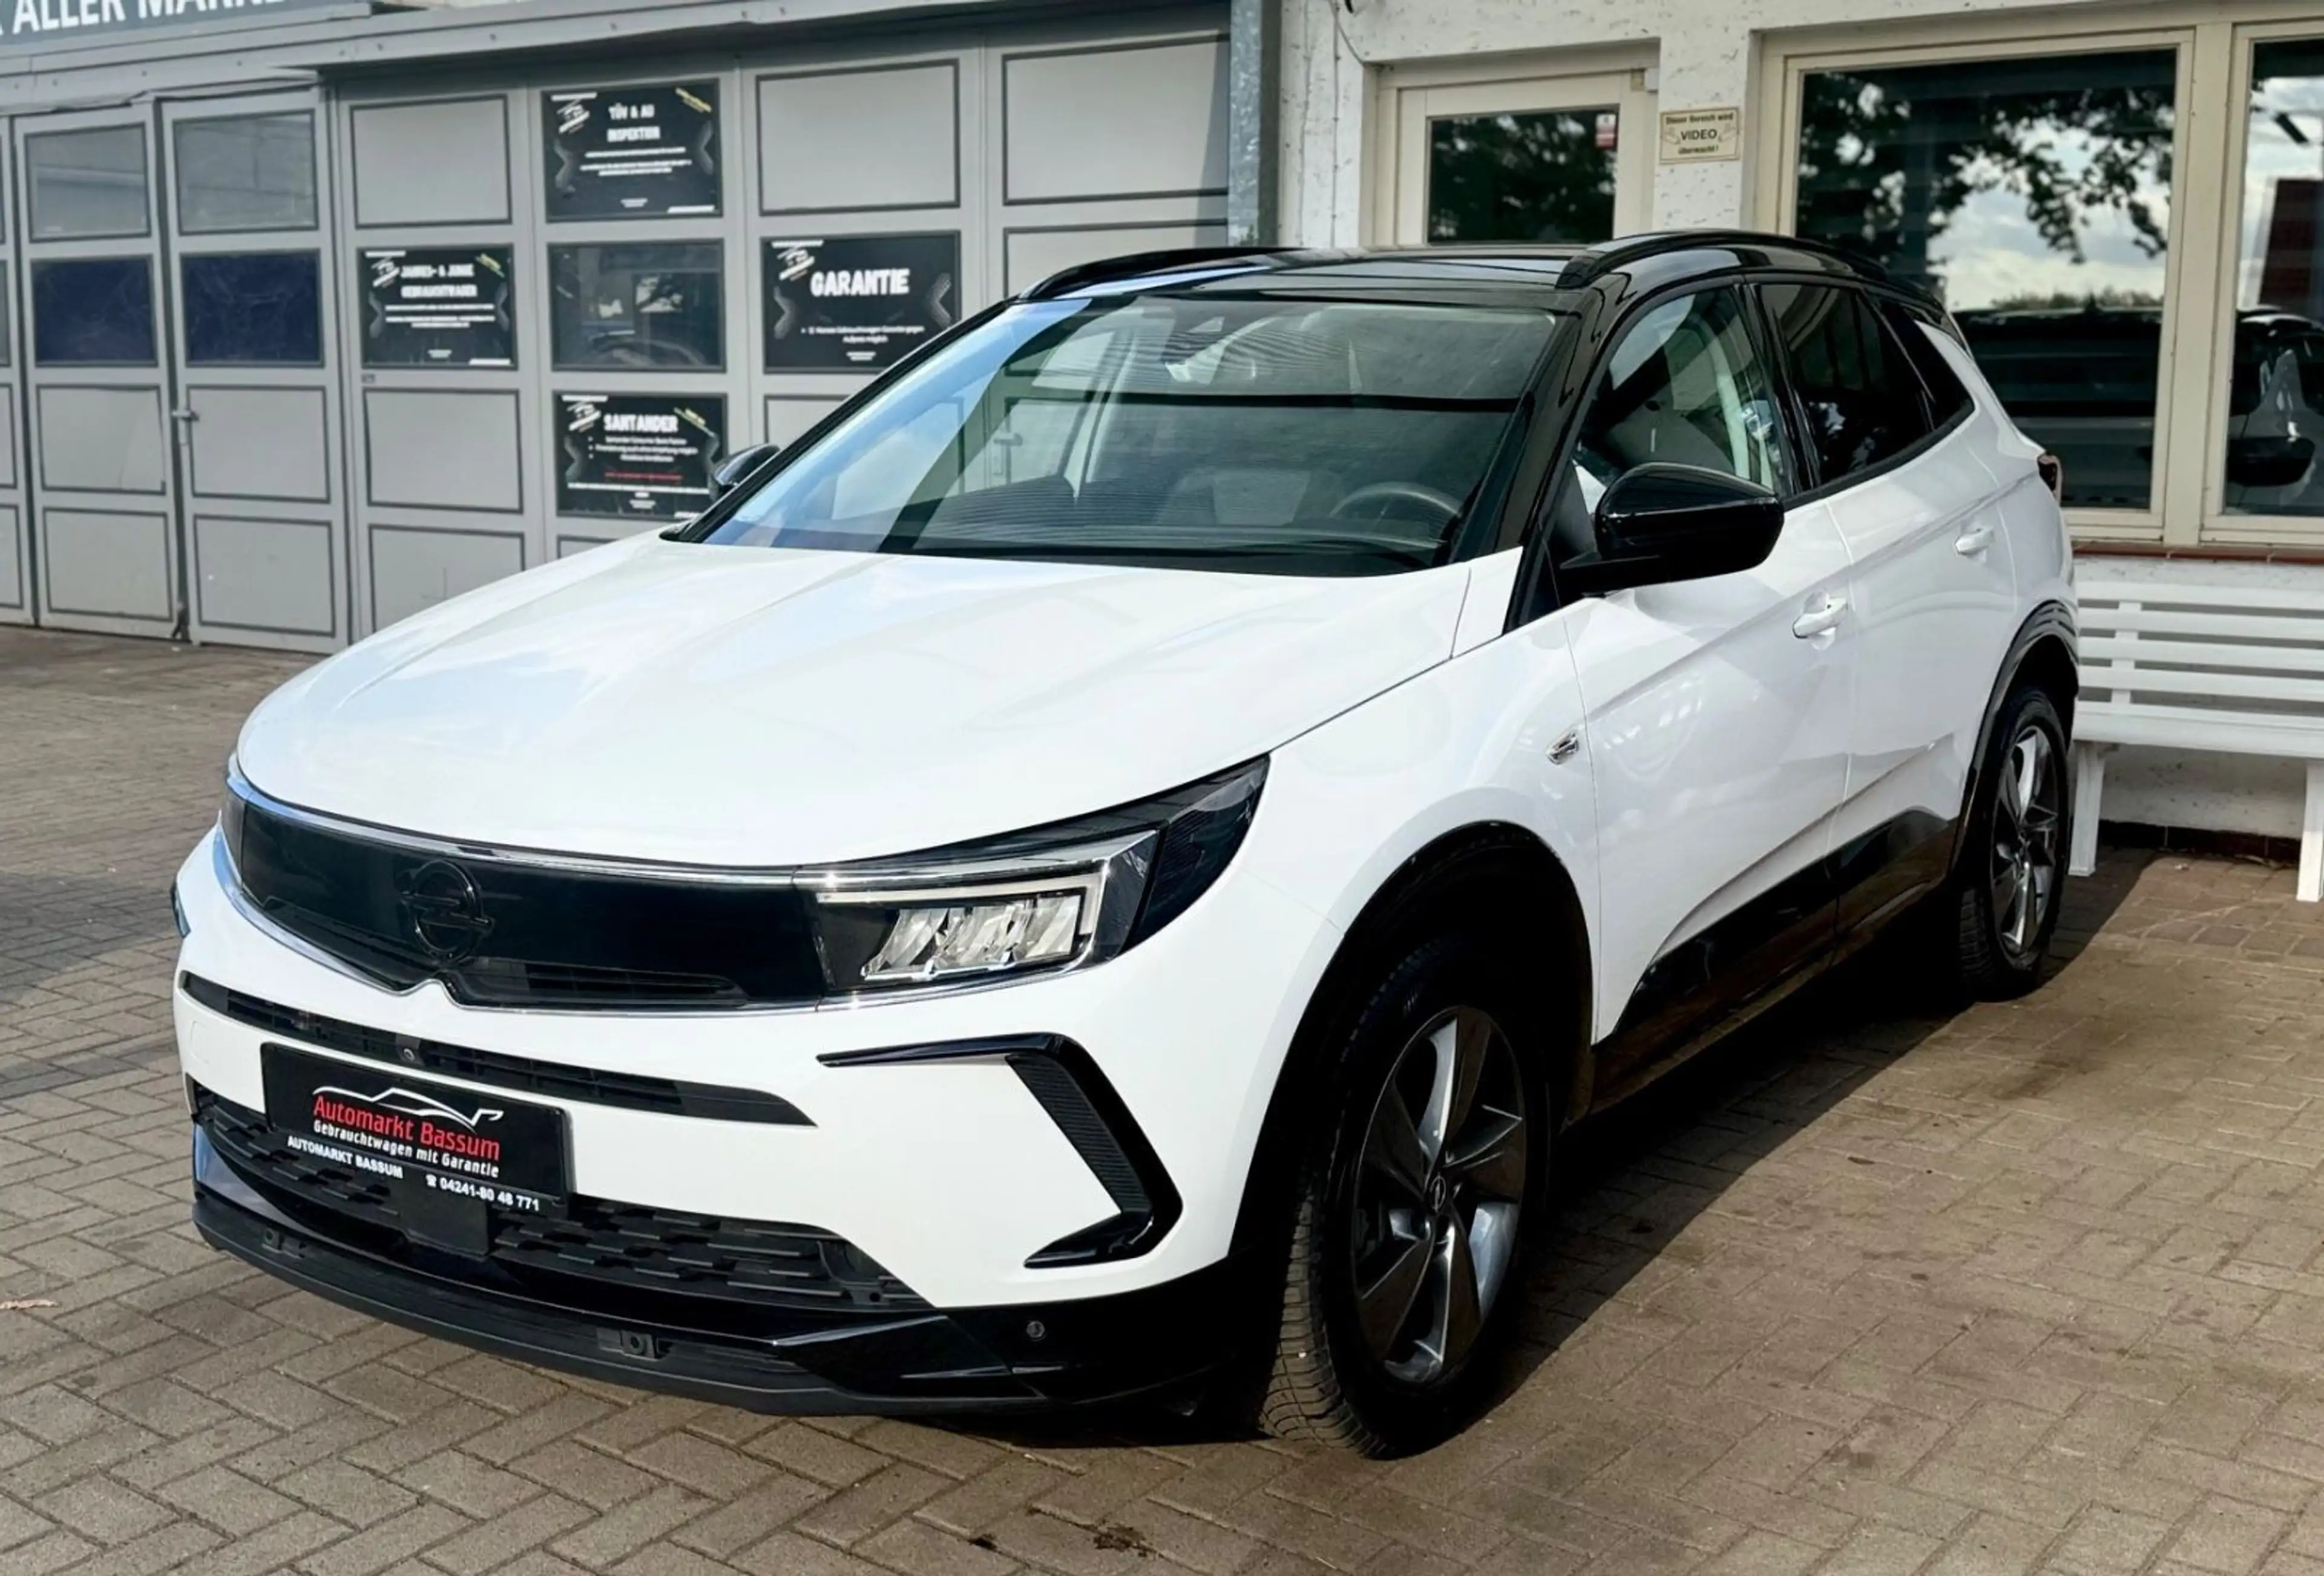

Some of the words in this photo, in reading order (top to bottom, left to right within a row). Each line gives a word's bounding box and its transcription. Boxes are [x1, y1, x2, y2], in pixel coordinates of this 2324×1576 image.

[12, 0, 126, 34] ALLER
[1680, 128, 1718, 140] VIDEO
[810, 268, 910, 297] GARANTIE
[603, 413, 678, 433] SANTANDER
[313, 1095, 415, 1140] Automarkt
[420, 1121, 500, 1161] Bassum
[287, 1135, 354, 1164] AUTOMARKT
[355, 1155, 404, 1179] BASSUM
[313, 1119, 413, 1157] Gebrauchtwagen
[416, 1148, 439, 1164] mit
[441, 1152, 499, 1178] Garantie
[439, 1177, 495, 1202] 04241-80
[515, 1194, 540, 1211] 771
